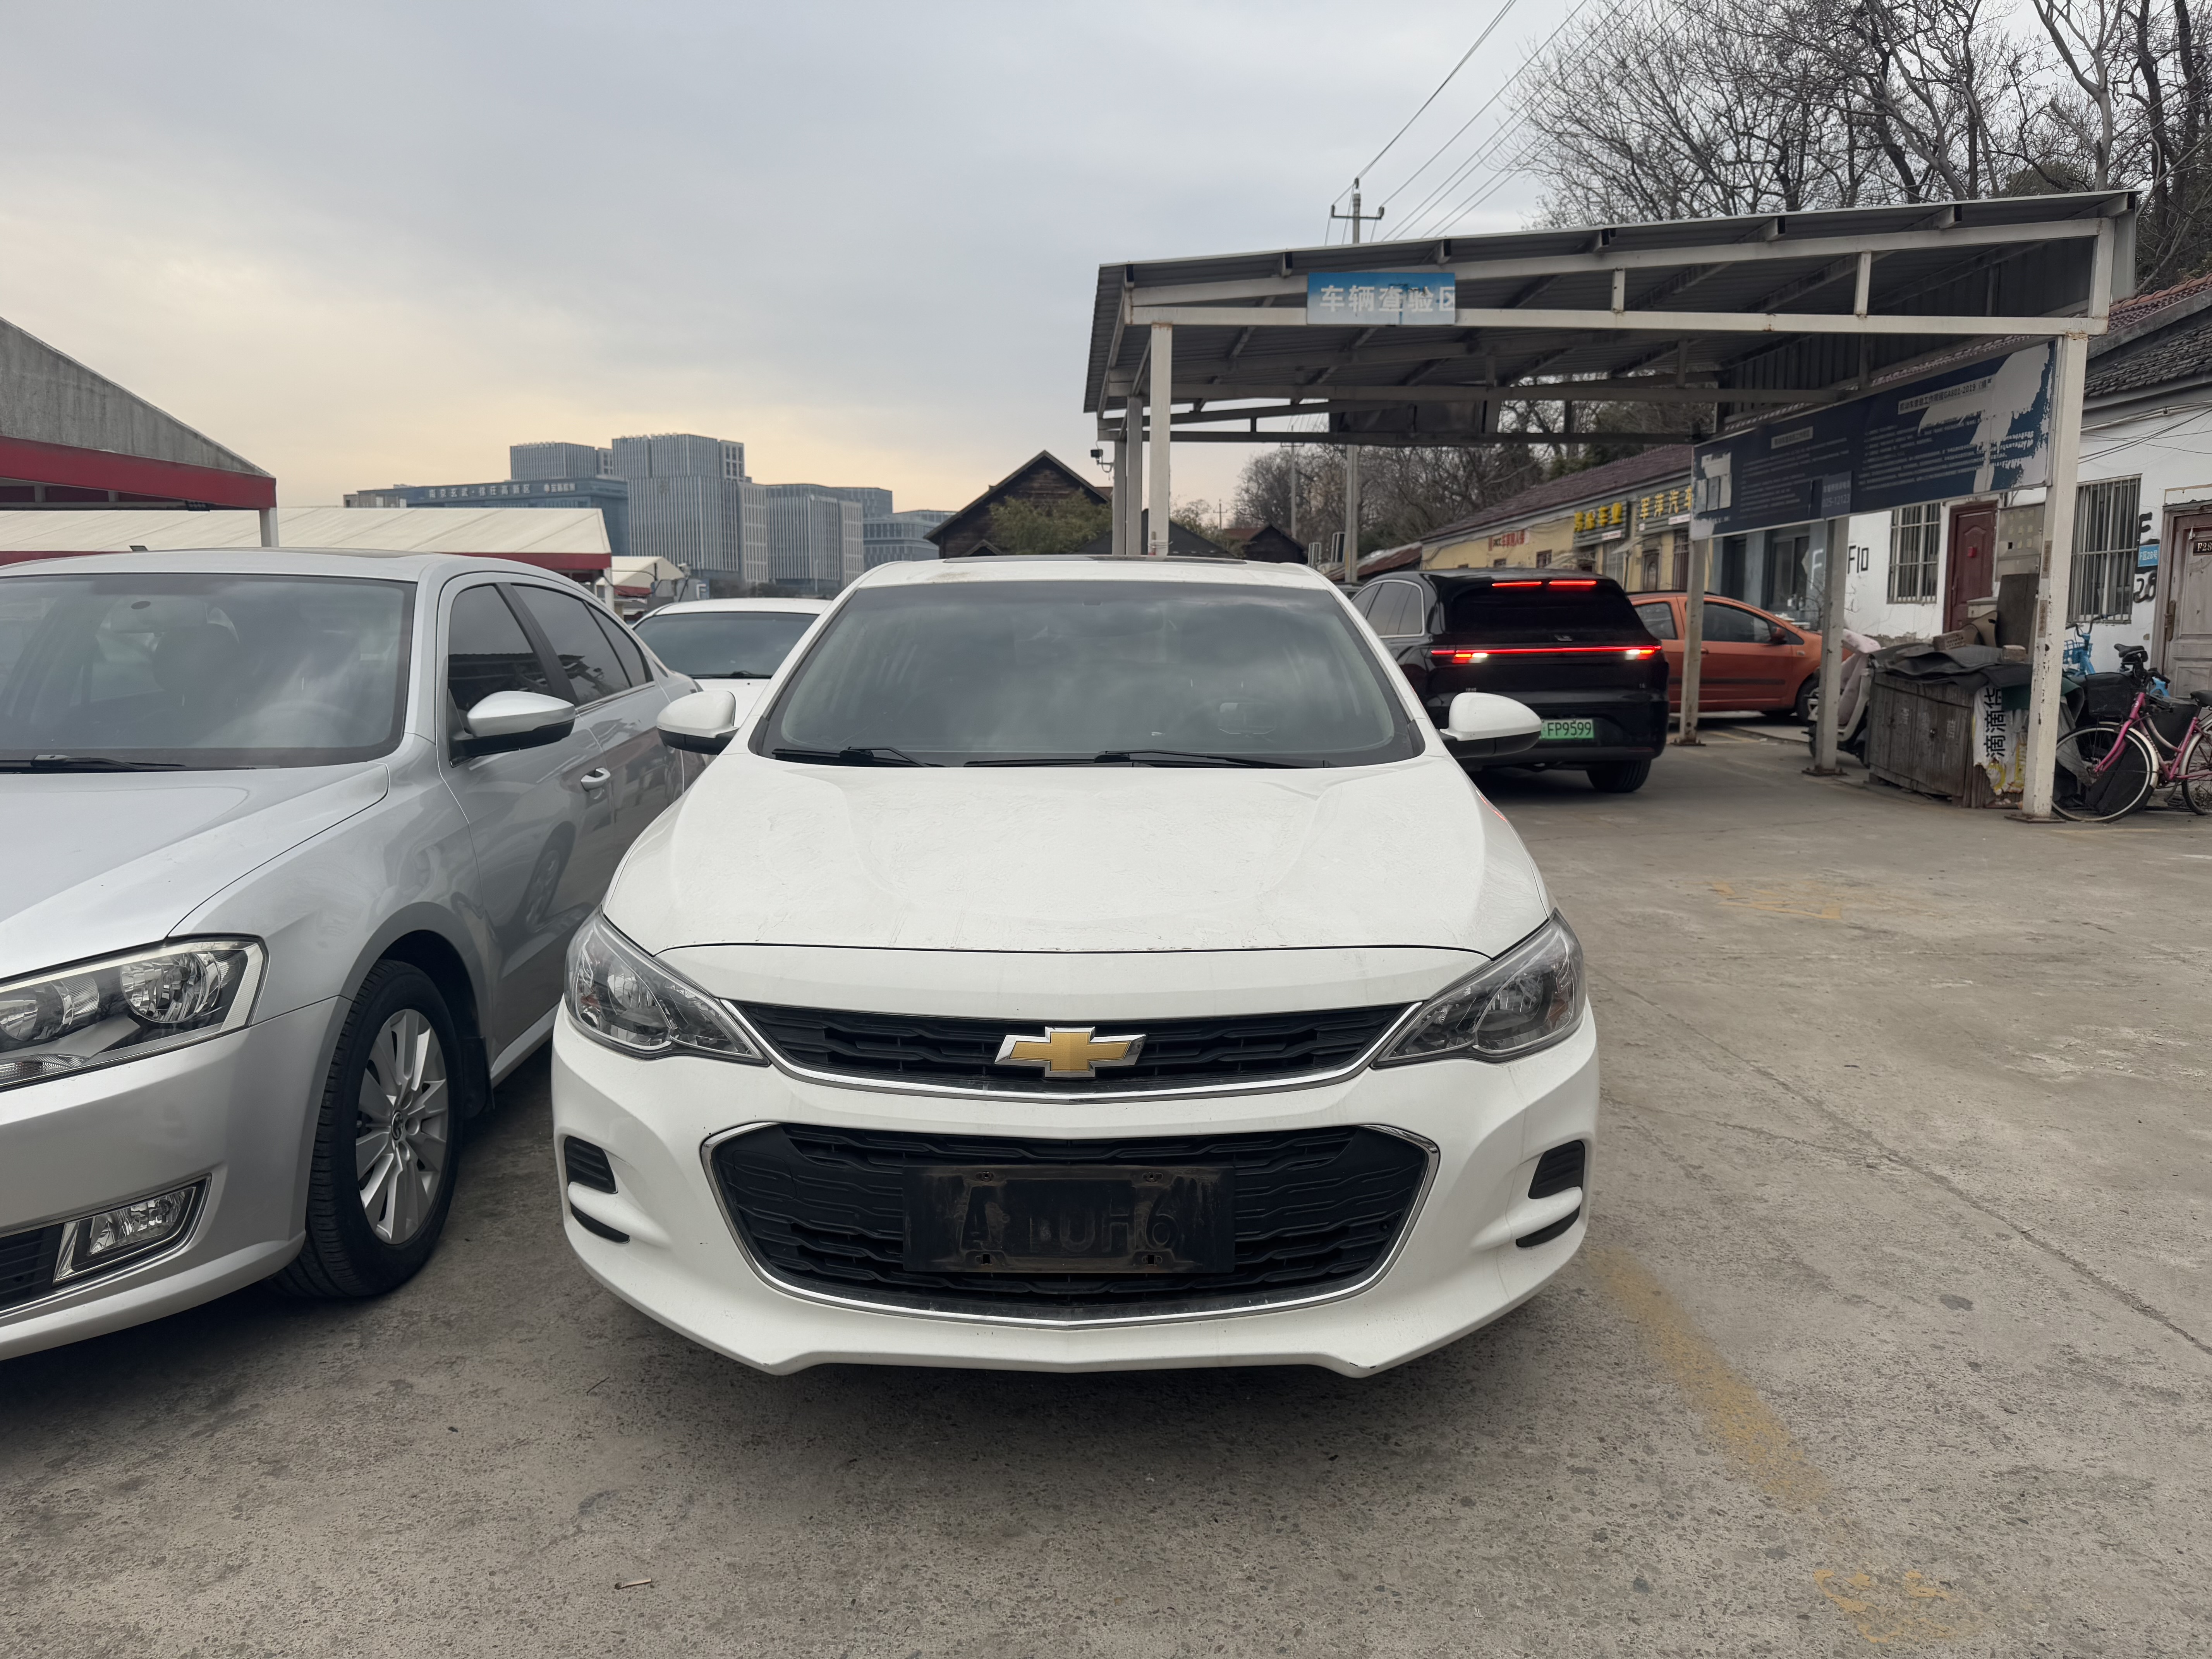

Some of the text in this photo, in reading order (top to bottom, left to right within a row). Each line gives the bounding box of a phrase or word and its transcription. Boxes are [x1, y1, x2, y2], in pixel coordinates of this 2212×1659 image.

[2197, 543, 2212, 551] F28
[2140, 550, 2158, 560] F区28号
[1547, 722, 1592, 736] FP9599
